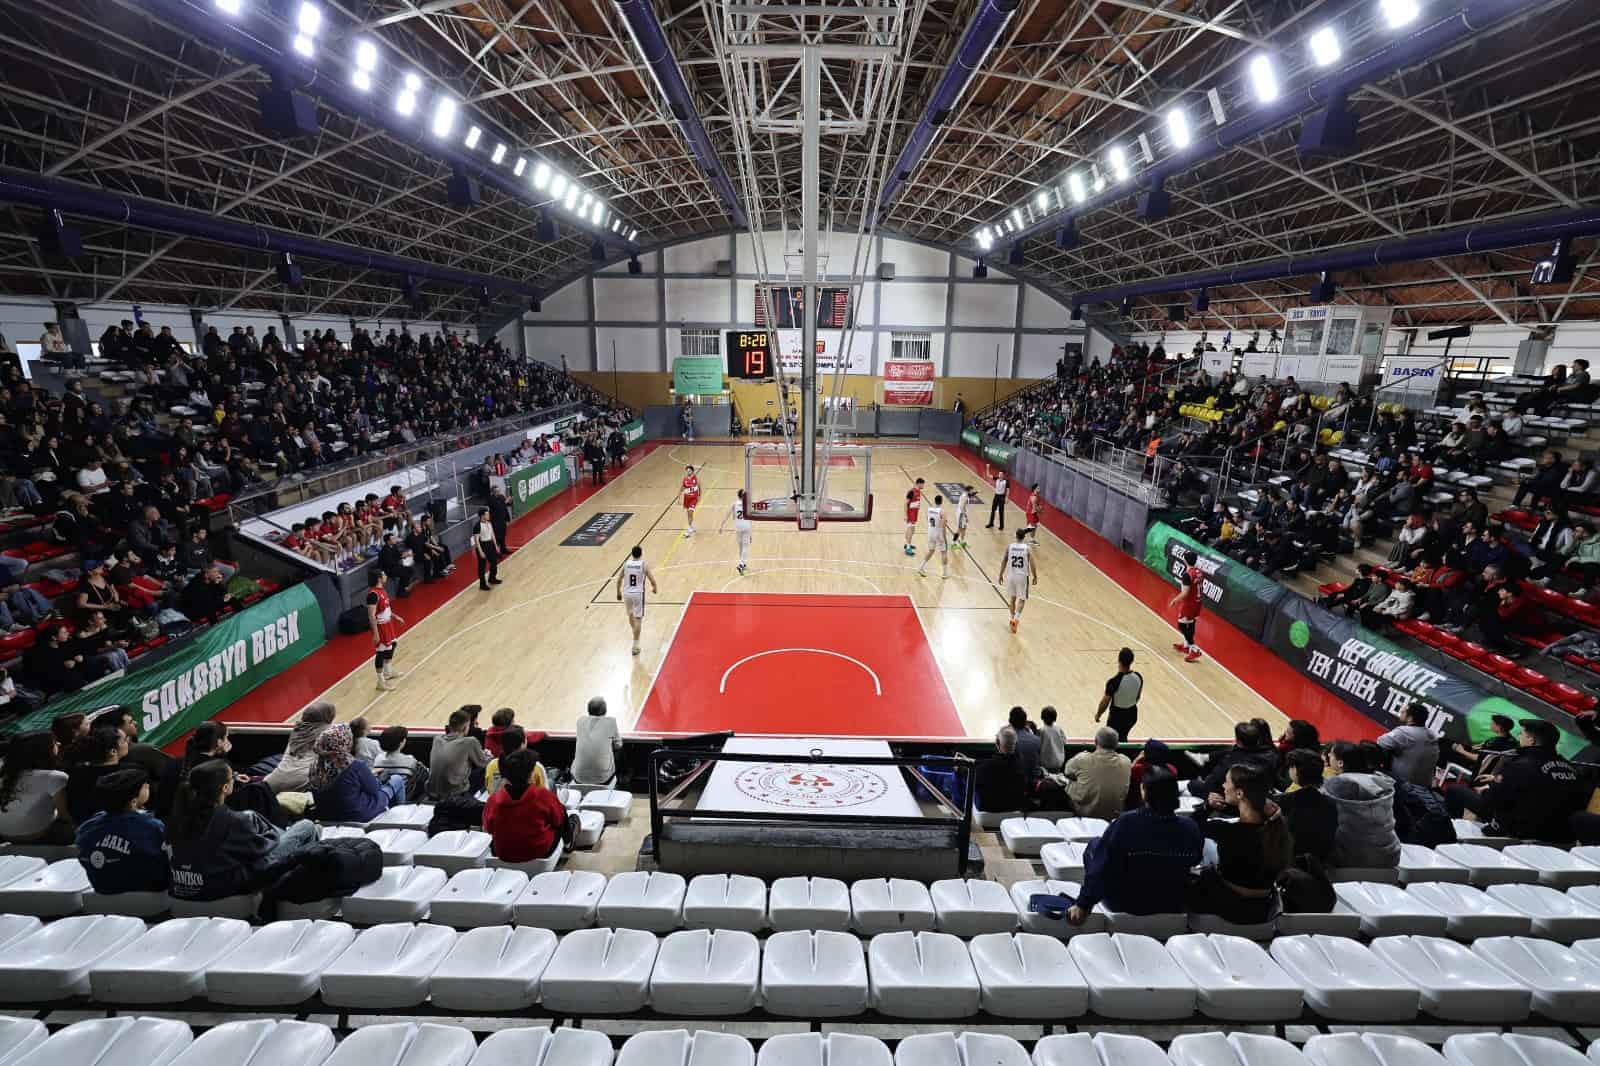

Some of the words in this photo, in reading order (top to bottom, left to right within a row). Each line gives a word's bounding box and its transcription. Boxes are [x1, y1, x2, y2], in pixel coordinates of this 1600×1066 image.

[745, 351, 764, 375] 19
[1011, 555, 1024, 569] 23
[630, 574, 637, 587] 8
[1337, 638, 1376, 665] HEP
[142, 640, 248, 732] SAKARYA
[251, 610, 300, 665] BBSK
[1307, 650, 1334, 680] TEK
[1332, 663, 1380, 706] YÜREK,
